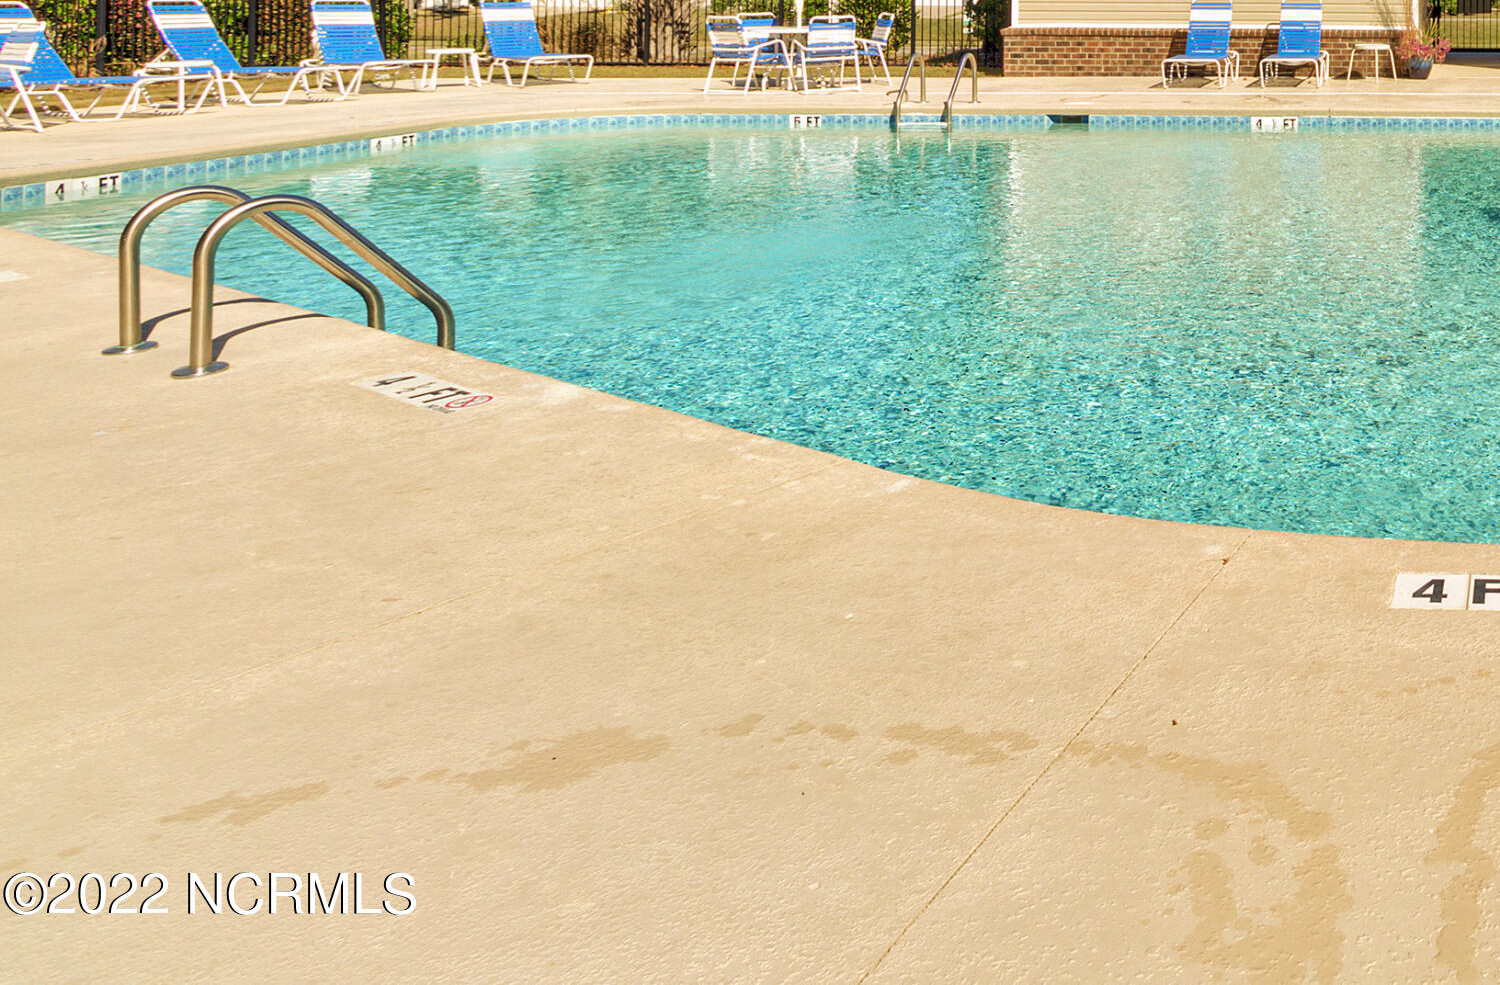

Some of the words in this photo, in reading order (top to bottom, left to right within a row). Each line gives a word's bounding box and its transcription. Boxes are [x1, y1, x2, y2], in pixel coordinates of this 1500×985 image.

[806, 116, 820, 127] FT
[1283, 118, 1296, 129] FT
[402, 135, 415, 146] FT
[408, 387, 472, 403] FT
[1412, 579, 1448, 603] 4
